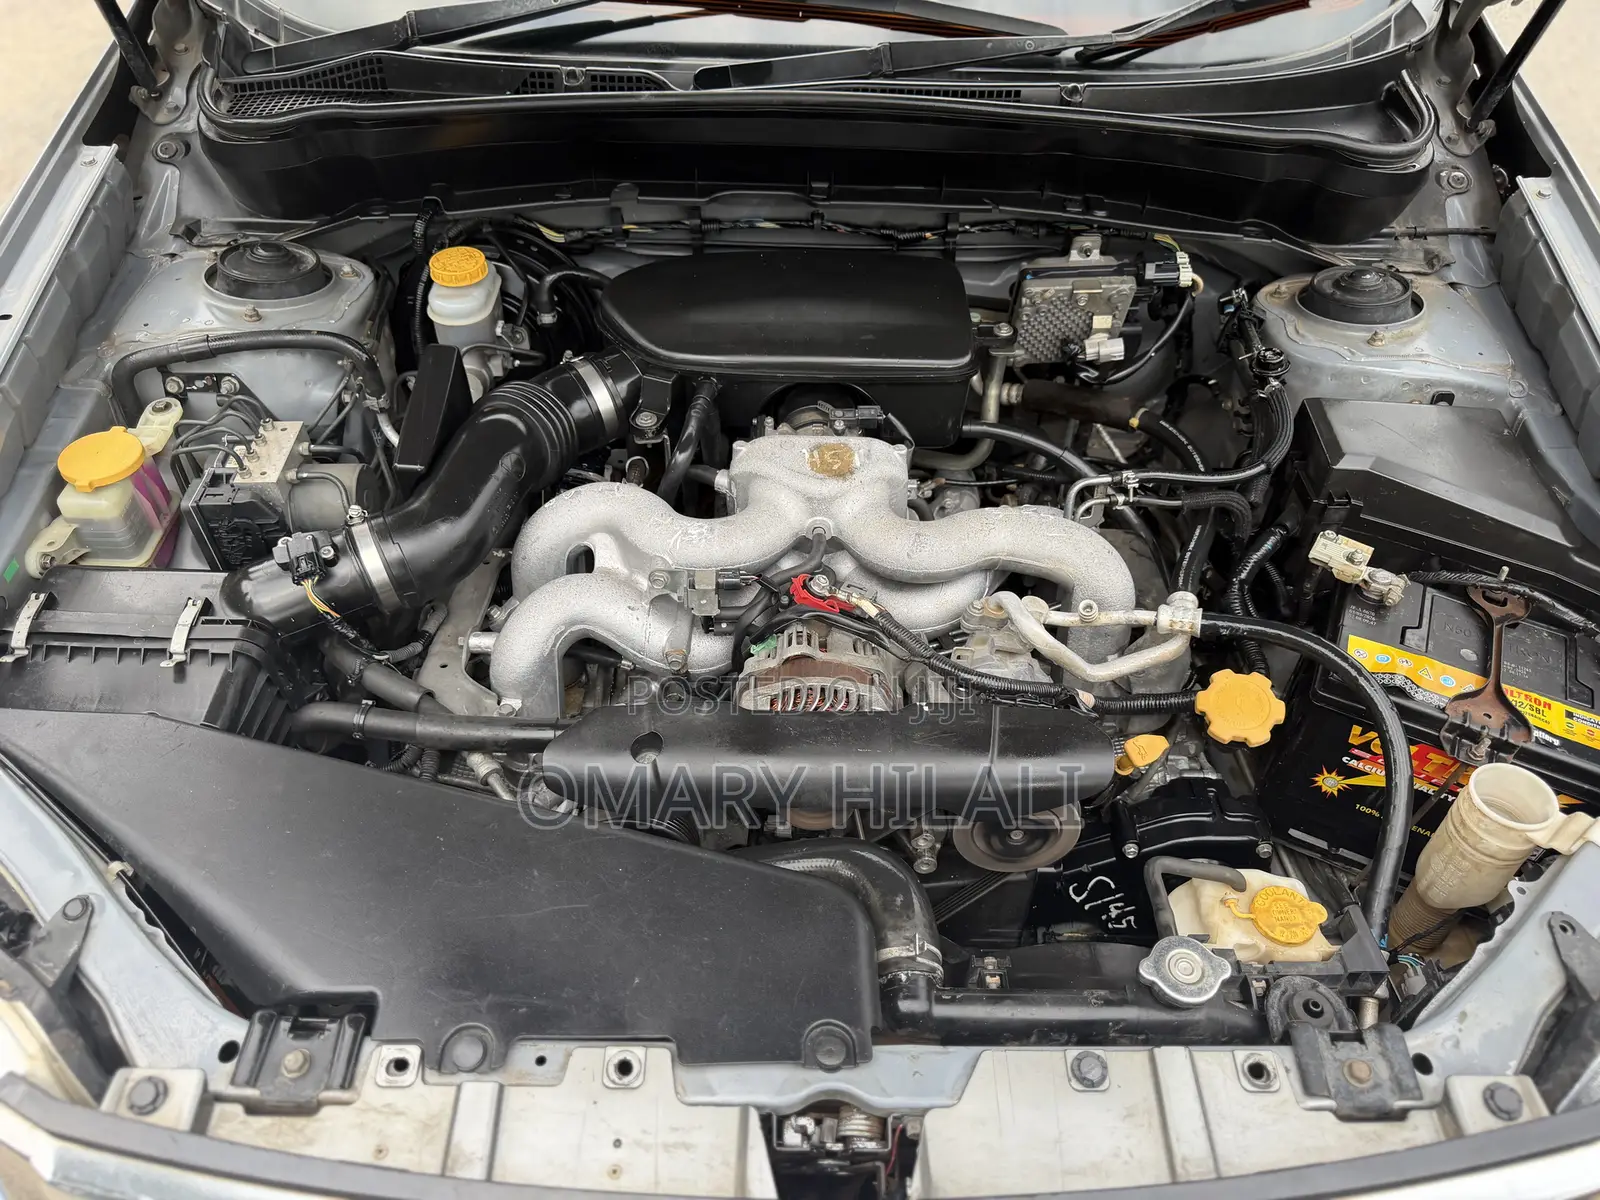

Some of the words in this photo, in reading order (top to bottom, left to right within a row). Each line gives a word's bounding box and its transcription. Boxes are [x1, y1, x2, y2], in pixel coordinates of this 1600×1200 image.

[1503, 686, 1552, 711] LTRON
[1354, 803, 1380, 818] 100%
[1253, 887, 1306, 907] COOLANT
